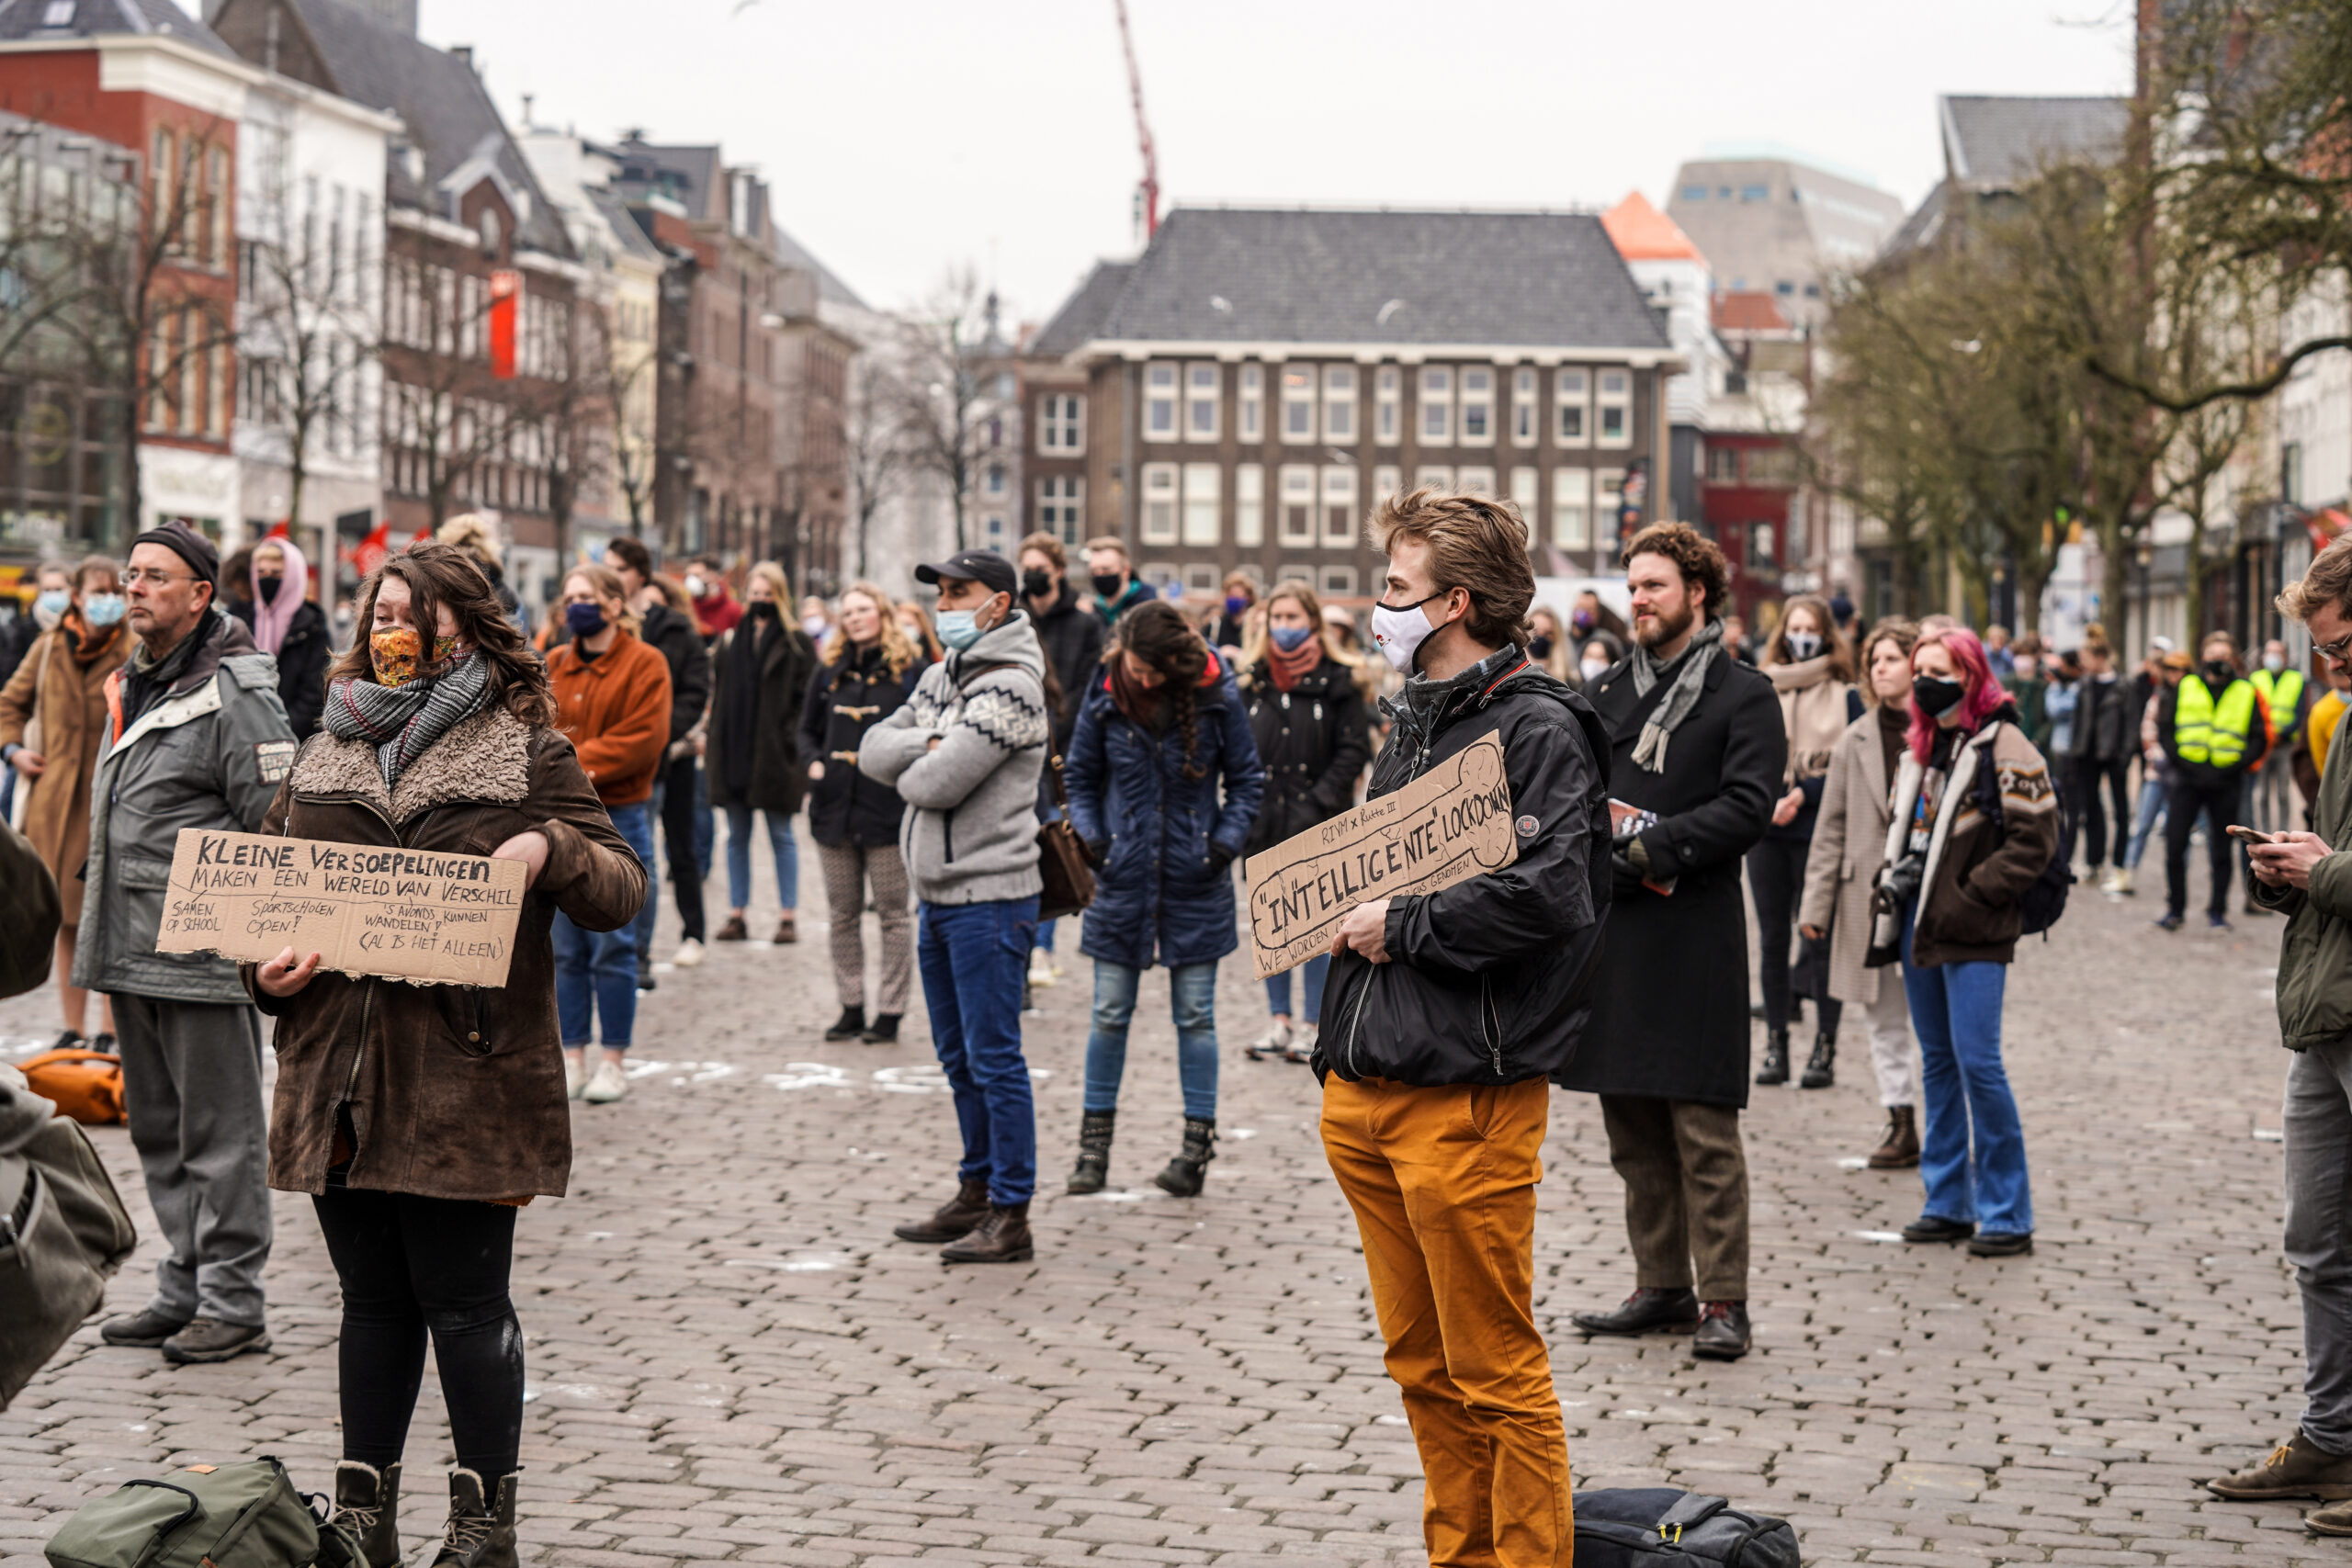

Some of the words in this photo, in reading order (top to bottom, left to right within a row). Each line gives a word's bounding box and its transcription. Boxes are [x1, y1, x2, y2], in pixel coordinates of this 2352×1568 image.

[1321, 818, 1350, 845] RIVM
[1361, 808, 1385, 824] Rutte
[1387, 801, 1396, 815] III
[1442, 783, 1510, 842] LOCKDOWN
[197, 835, 295, 869] KLEINE
[190, 867, 257, 891] MAKEN
[274, 870, 309, 887] EEN
[324, 873, 390, 896] WERELD
[397, 881, 431, 897] VAN
[442, 881, 518, 905] VERSCHIL
[1430, 858, 1469, 887] GENOMEN
[172, 900, 216, 917] SAMEN
[252, 900, 336, 917] SPORTSCHOLEN
[398, 905, 435, 919] AVONDS
[443, 909, 488, 923] KUNNEN
[165, 919, 179, 933] OP
[183, 918, 220, 932] SCHOOL
[359, 931, 383, 953] (AL
[412, 935, 440, 952] HET
[443, 937, 504, 961] ALLEEN)
[1258, 949, 1283, 971] WE
[1288, 928, 1329, 960] WORDEN
